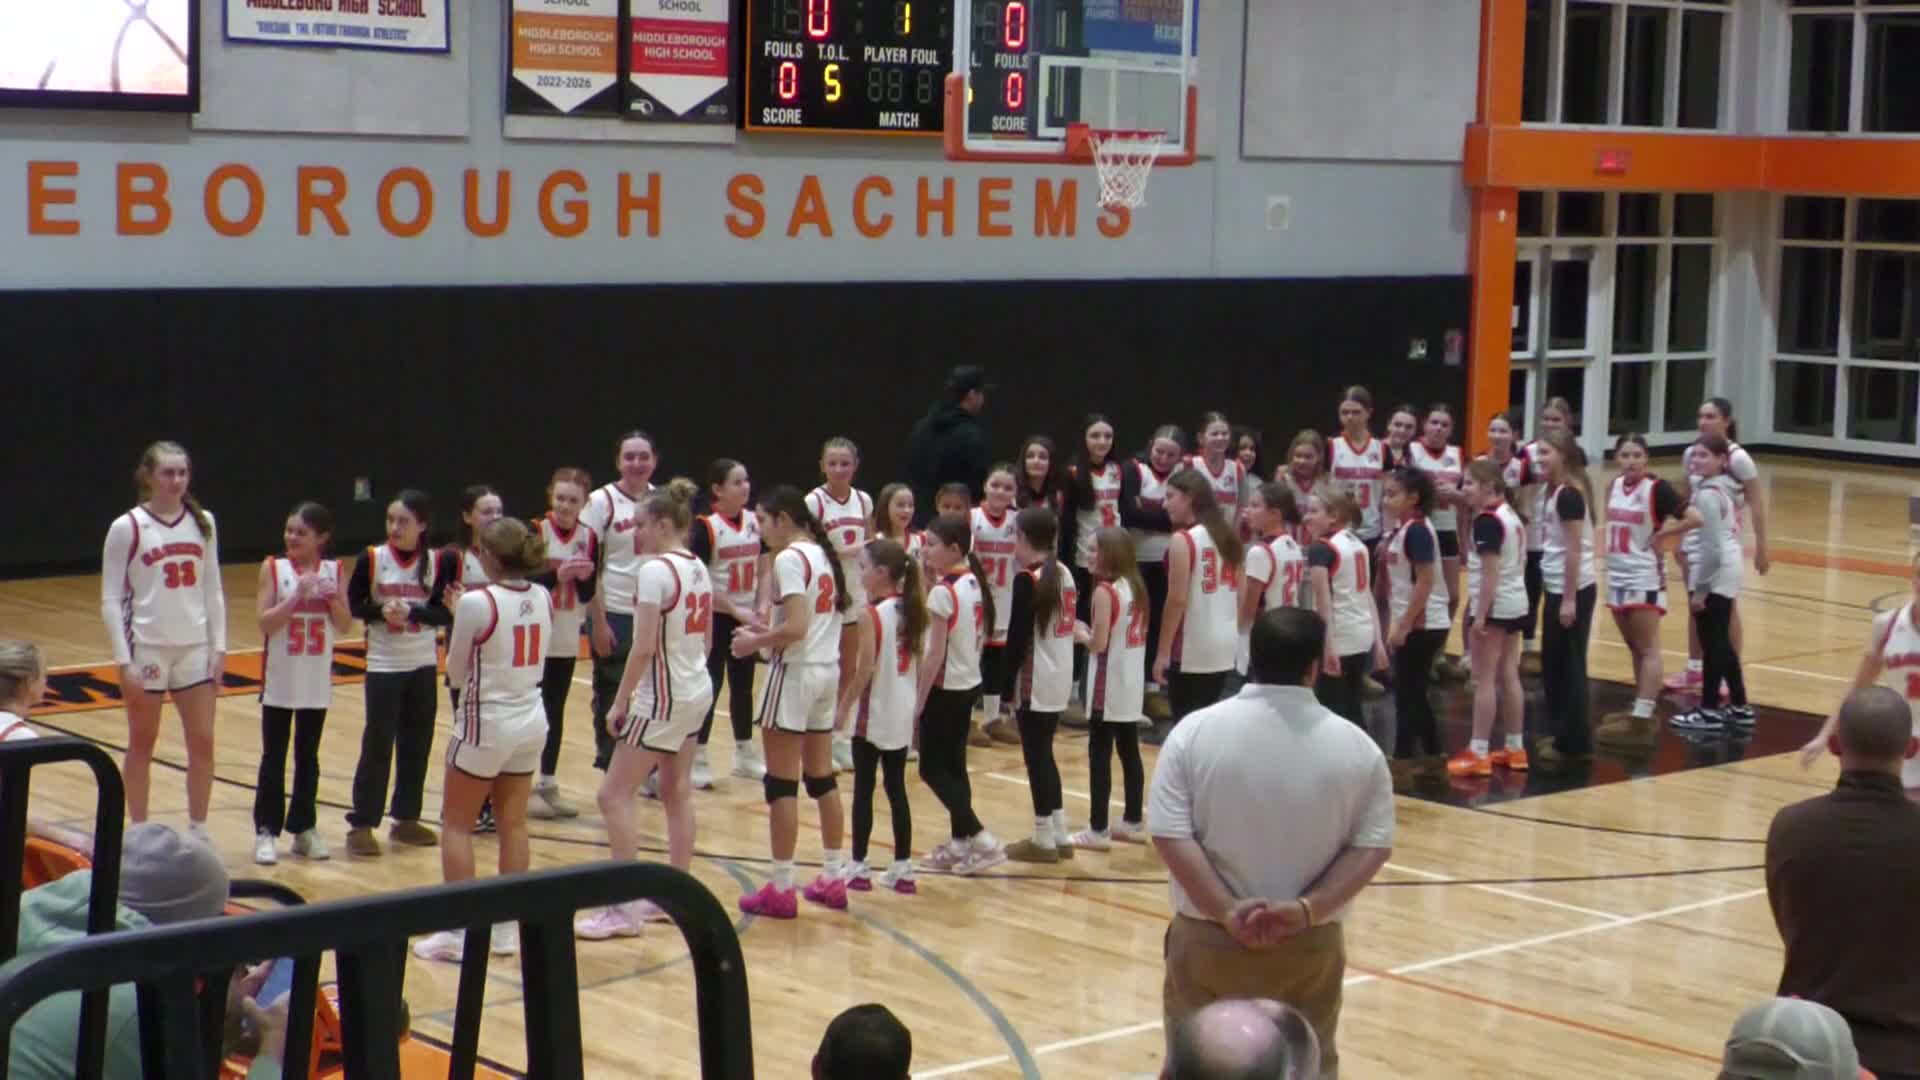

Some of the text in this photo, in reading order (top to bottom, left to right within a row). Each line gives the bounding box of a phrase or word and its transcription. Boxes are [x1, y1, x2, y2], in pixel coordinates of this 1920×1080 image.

[338, 0, 369, 14] HIGH
[378, 0, 426, 17] SCHOOL
[658, 0, 702, 12] SCHOOL
[808, 0, 828, 37] 0
[903, 2, 912, 34] 1
[1005, 2, 1025, 47] 0
[519, 27, 614, 43] MIDDLEBOROUGH
[633, 32, 726, 48] MIDDLEBOROUGH
[529, 43, 603, 57] HIGH SCHOOL
[644, 48, 715, 61] HIGH SCHOOL
[764, 41, 804, 58] FOULS
[818, 44, 850, 61] T.O.L.
[863, 46, 940, 65] PLAYER FOUL
[994, 53, 1029, 69] FOULS
[536, 75, 592, 89] 2022-2026
[779, 62, 797, 99] 0
[824, 64, 841, 102] 5
[1007, 72, 1023, 108] 0
[763, 109, 802, 125] SCORE
[879, 112, 920, 128] MATCH
[991, 116, 1027, 131] SCORE
[26, 160, 662, 238] EBOROUGH
[843, 529, 857, 546] 9
[287, 618, 326, 656] 55
[512, 623, 541, 668] 11
